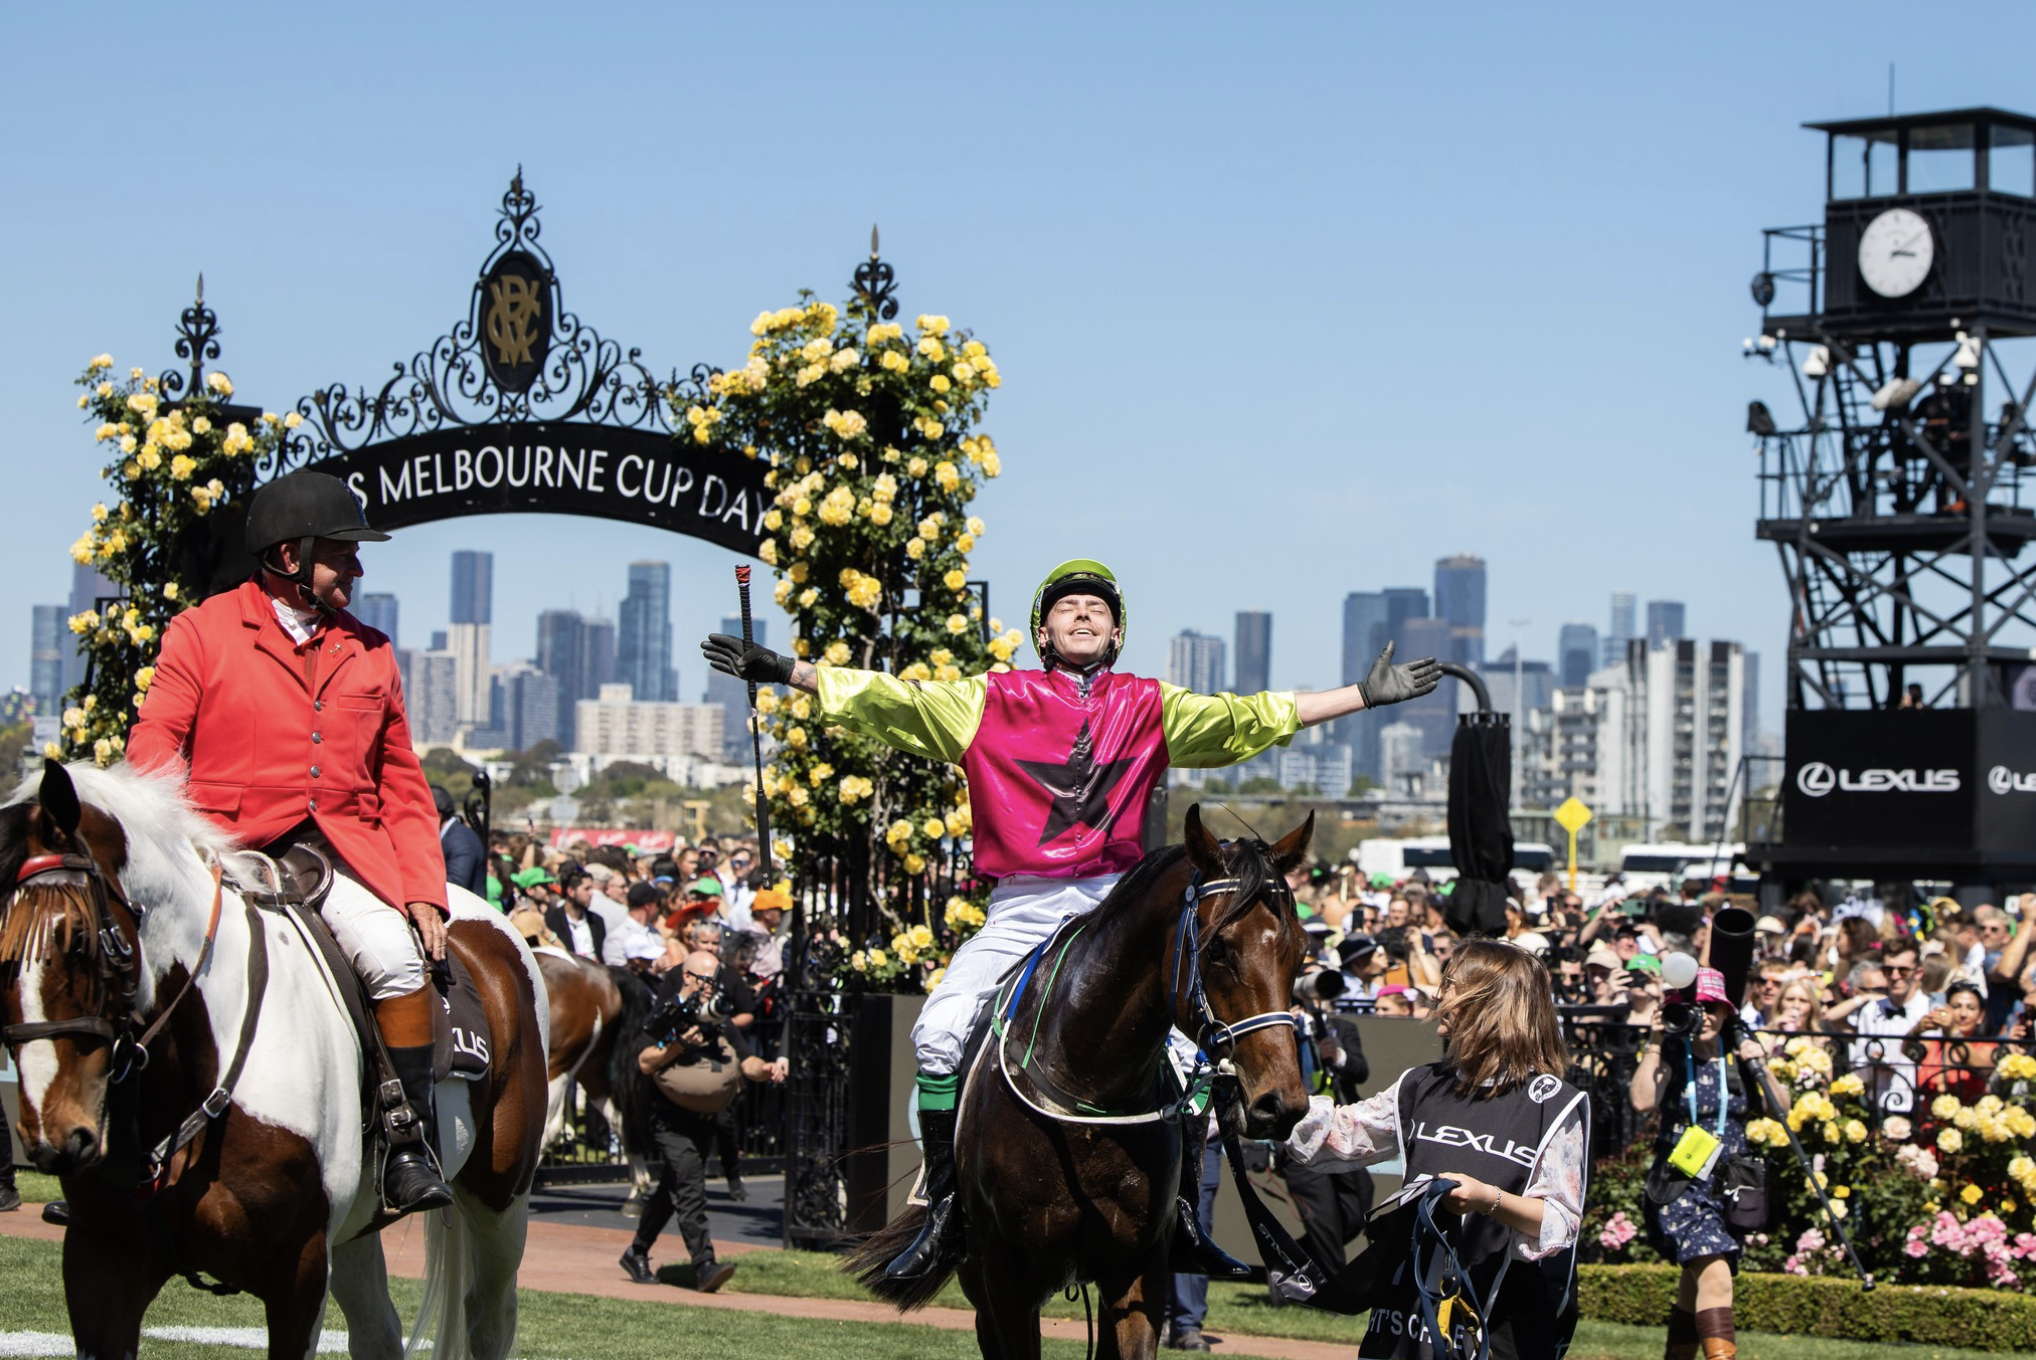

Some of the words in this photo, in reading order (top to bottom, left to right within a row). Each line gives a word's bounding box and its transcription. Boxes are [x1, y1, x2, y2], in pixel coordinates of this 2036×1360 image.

[379, 445, 609, 505] MELBOURNE
[616, 454, 693, 508] CUP
[699, 474, 776, 536] DAY
[1838, 769, 1961, 791] LEXUS
[1416, 1122, 1537, 1168] LEXUS
